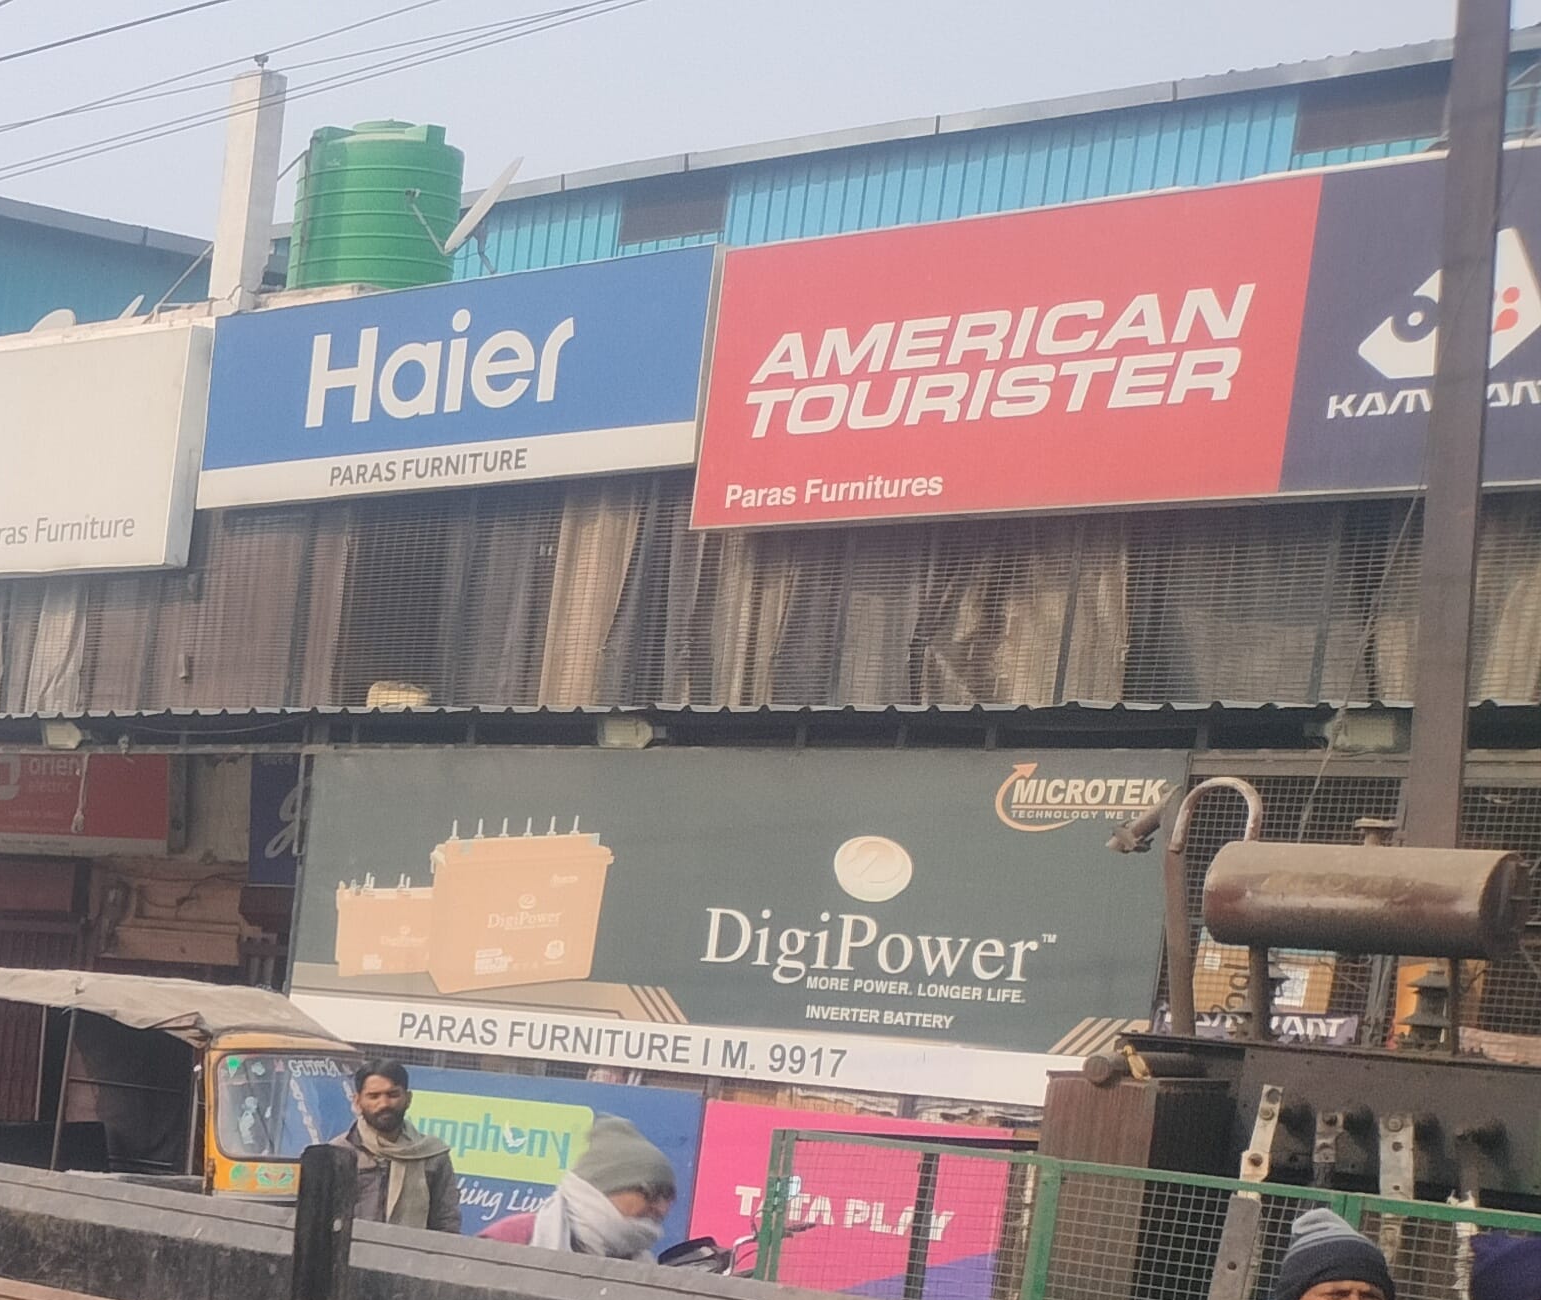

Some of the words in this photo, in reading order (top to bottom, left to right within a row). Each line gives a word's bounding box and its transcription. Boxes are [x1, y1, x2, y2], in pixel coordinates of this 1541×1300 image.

[749, 282, 1258, 384] AMERICAN
[304, 308, 575, 429] Haier
[744, 347, 1243, 438] TOURISTER
[329, 461, 396, 487] PARAS
[402, 448, 528, 482] FURNITURE
[724, 483, 797, 508] Paras
[805, 474, 944, 505] Furnitures
[34, 513, 136, 545] Furniture
[1012, 779, 1166, 804] MICROTEK
[1011, 810, 1099, 819] TECHNOLOGY
[1105, 811, 1124, 819] WE
[700, 907, 1039, 985] DigiPower
[806, 976, 850, 991] MORE
[853, 978, 914, 996] POWER.
[917, 984, 982, 1000] LONGER
[986, 989, 1026, 1004] LIFE.
[805, 1004, 880, 1024] INVERTER
[882, 1010, 954, 1030] BATTERY
[398, 1010, 500, 1046] PARAS
[508, 1019, 692, 1065] FURNITURE
[768, 1047, 848, 1079] 9917
[417, 1113, 571, 1170] mphony
